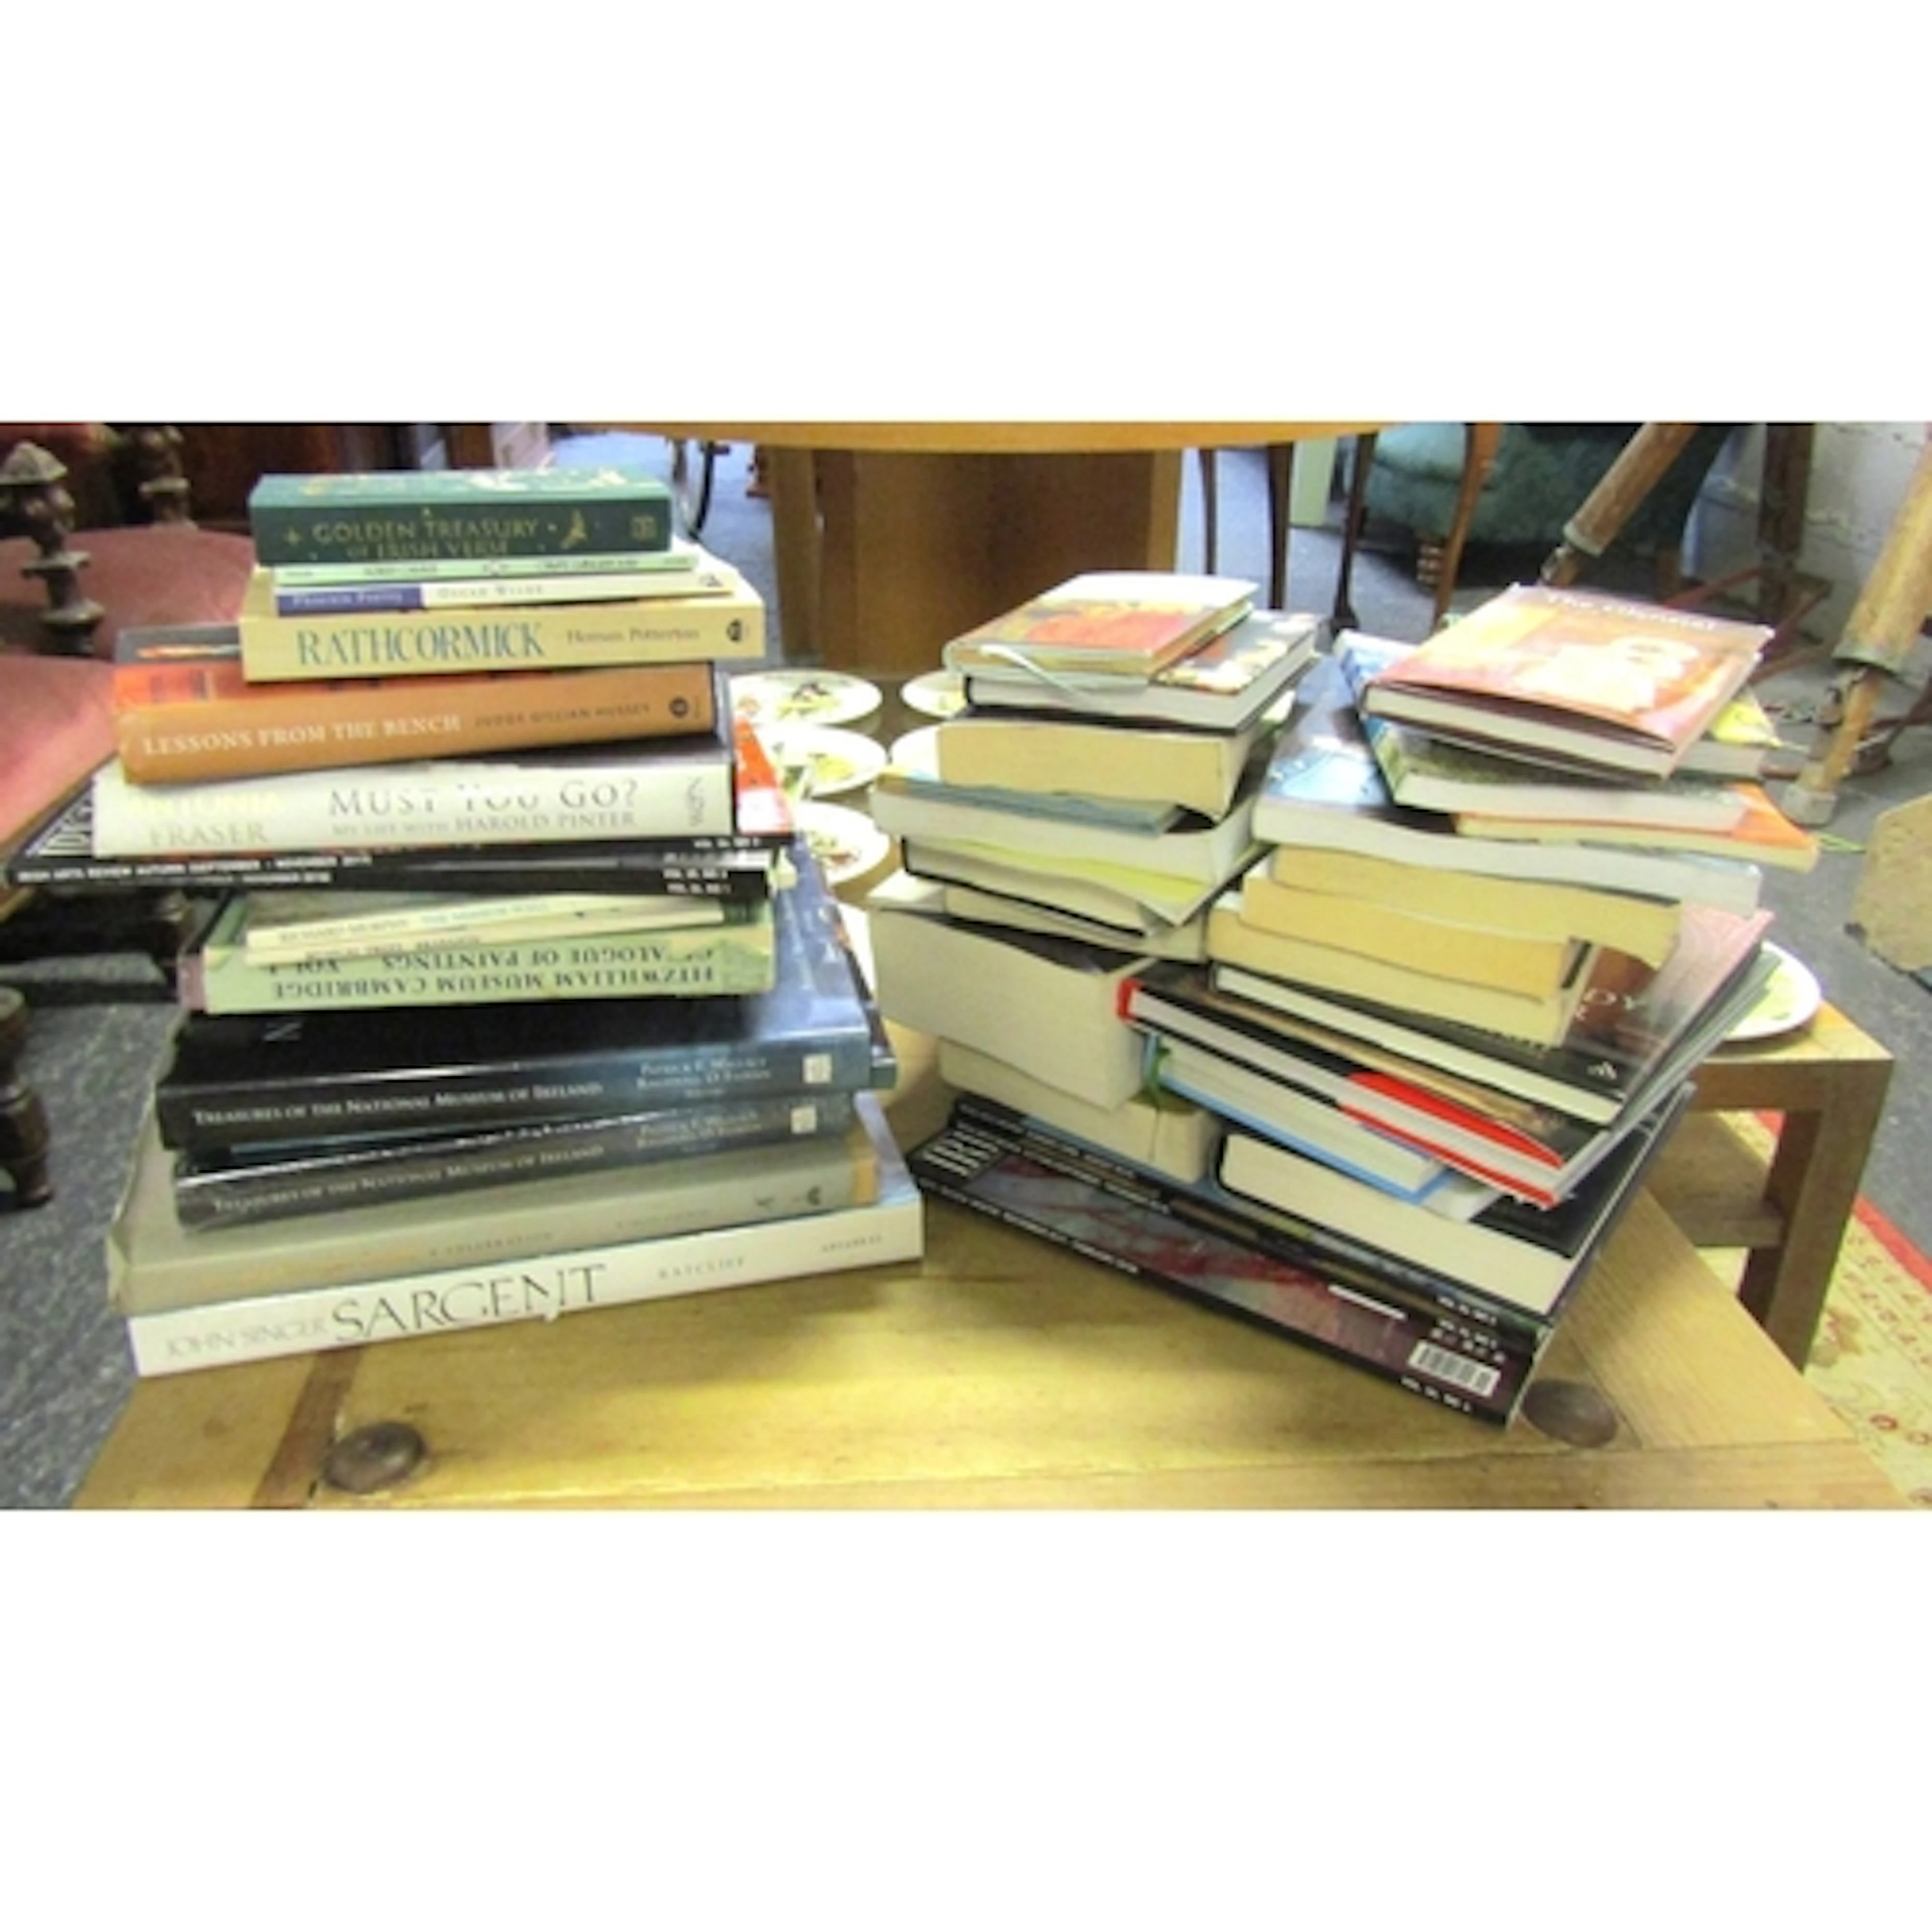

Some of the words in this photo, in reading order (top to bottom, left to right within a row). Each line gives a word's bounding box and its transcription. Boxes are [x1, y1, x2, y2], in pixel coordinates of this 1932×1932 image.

[312, 522, 416, 544] GOLDEN
[424, 518, 538, 539] TREASURY
[296, 623, 546, 666] RATHCORMICK
[144, 732, 254, 755] LESSONS
[258, 727, 326, 747] FROM
[334, 721, 377, 740] THE
[384, 715, 461, 736] BENCH
[330, 787, 437, 817] MUST
[455, 811, 550, 830] HAROLD
[558, 809, 637, 828] PINTER
[149, 821, 269, 847] FRASER
[381, 952, 519, 973] PAINTINGS
[528, 949, 559, 968] OF
[567, 945, 713, 965] CALOGUE
[271, 976, 426, 1000] CAMBRIDGE
[436, 972, 544, 993] MUSEUM
[553, 965, 713, 989] FITZWILLIAM
[312, 1102, 342, 1116] THE
[347, 1095, 431, 1112] NATIONAL
[435, 1088, 503, 1105] MUSEUM
[532, 1081, 603, 1100] IRELAND
[166, 1330, 234, 1358] JOHN
[330, 1263, 607, 1343] SARGENT
